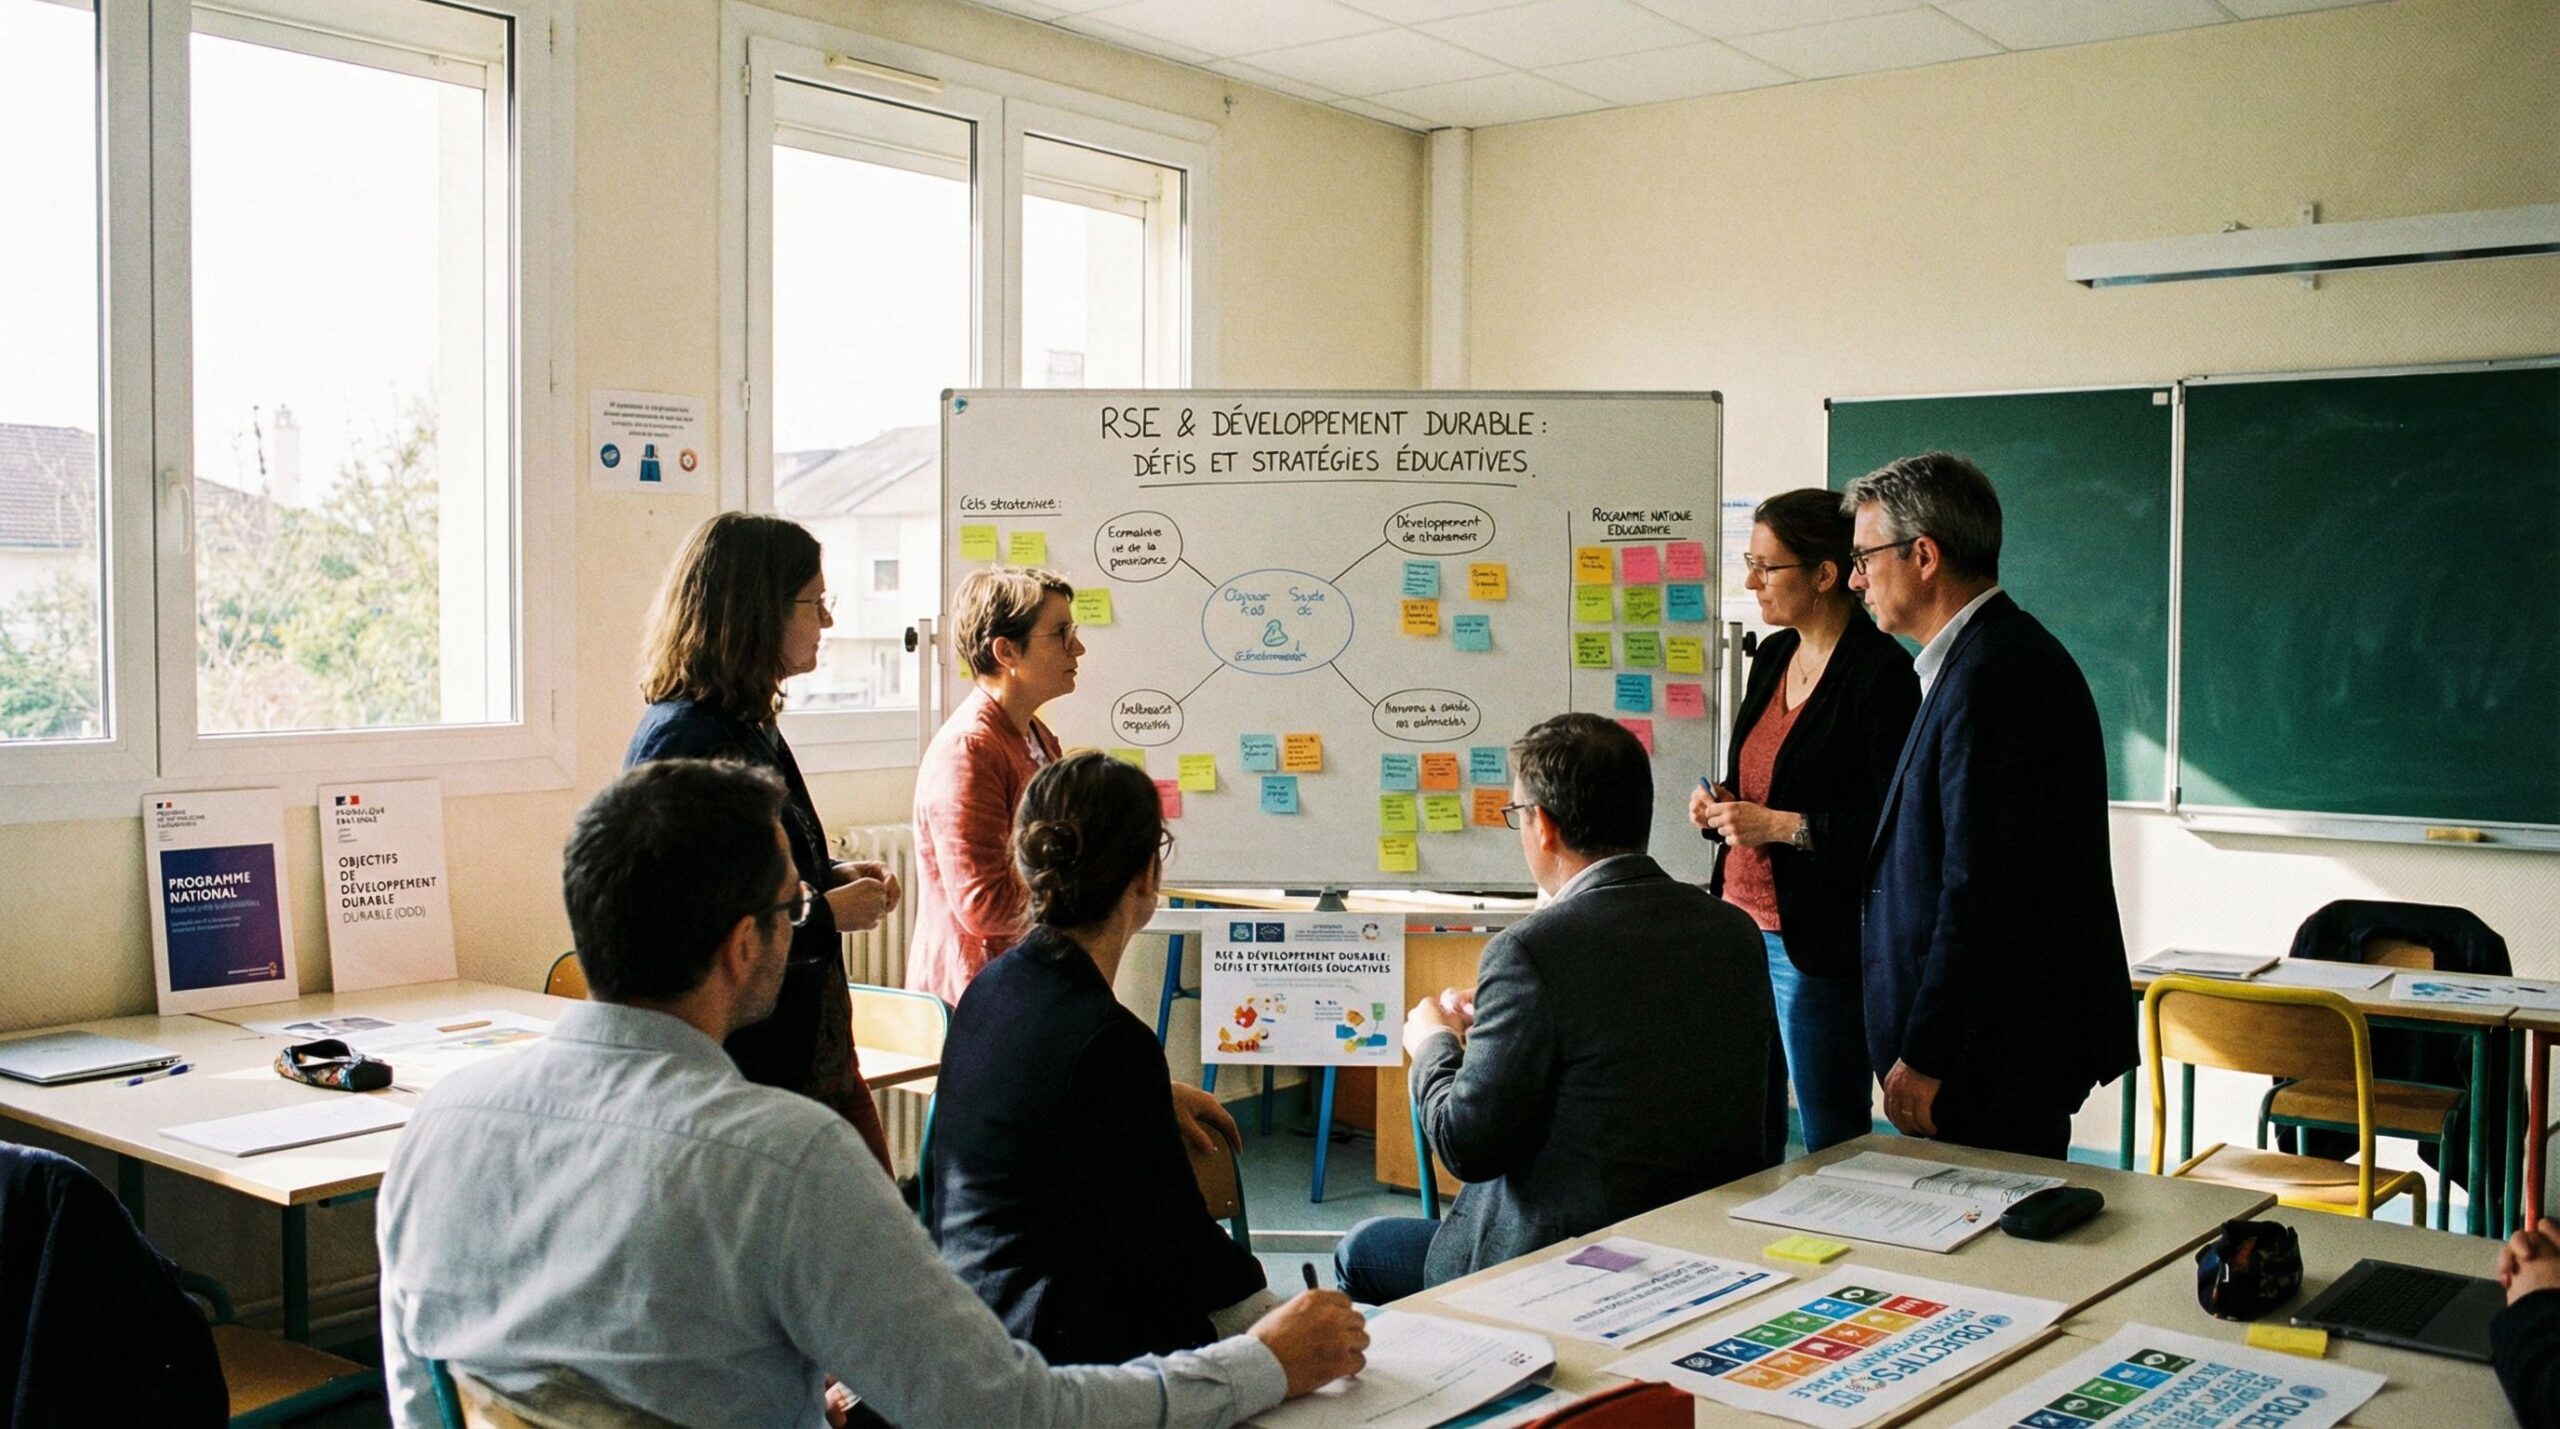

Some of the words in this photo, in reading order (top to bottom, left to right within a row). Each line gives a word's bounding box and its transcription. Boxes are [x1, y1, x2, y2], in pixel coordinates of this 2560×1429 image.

[1101, 406, 1161, 439] RSE
[1177, 407, 1196, 437] &
[1211, 403, 1408, 436] DÉVELOPPEMENT
[1210, 451, 1239, 473] ET
[338, 852, 399, 869] OBJECTIFS
[168, 871, 252, 890] PROGRAMME
[340, 869, 356, 882] DE
[169, 886, 238, 905] NATIONAL
[341, 893, 395, 909] DURABLE
[342, 908, 393, 924] DURABLE
